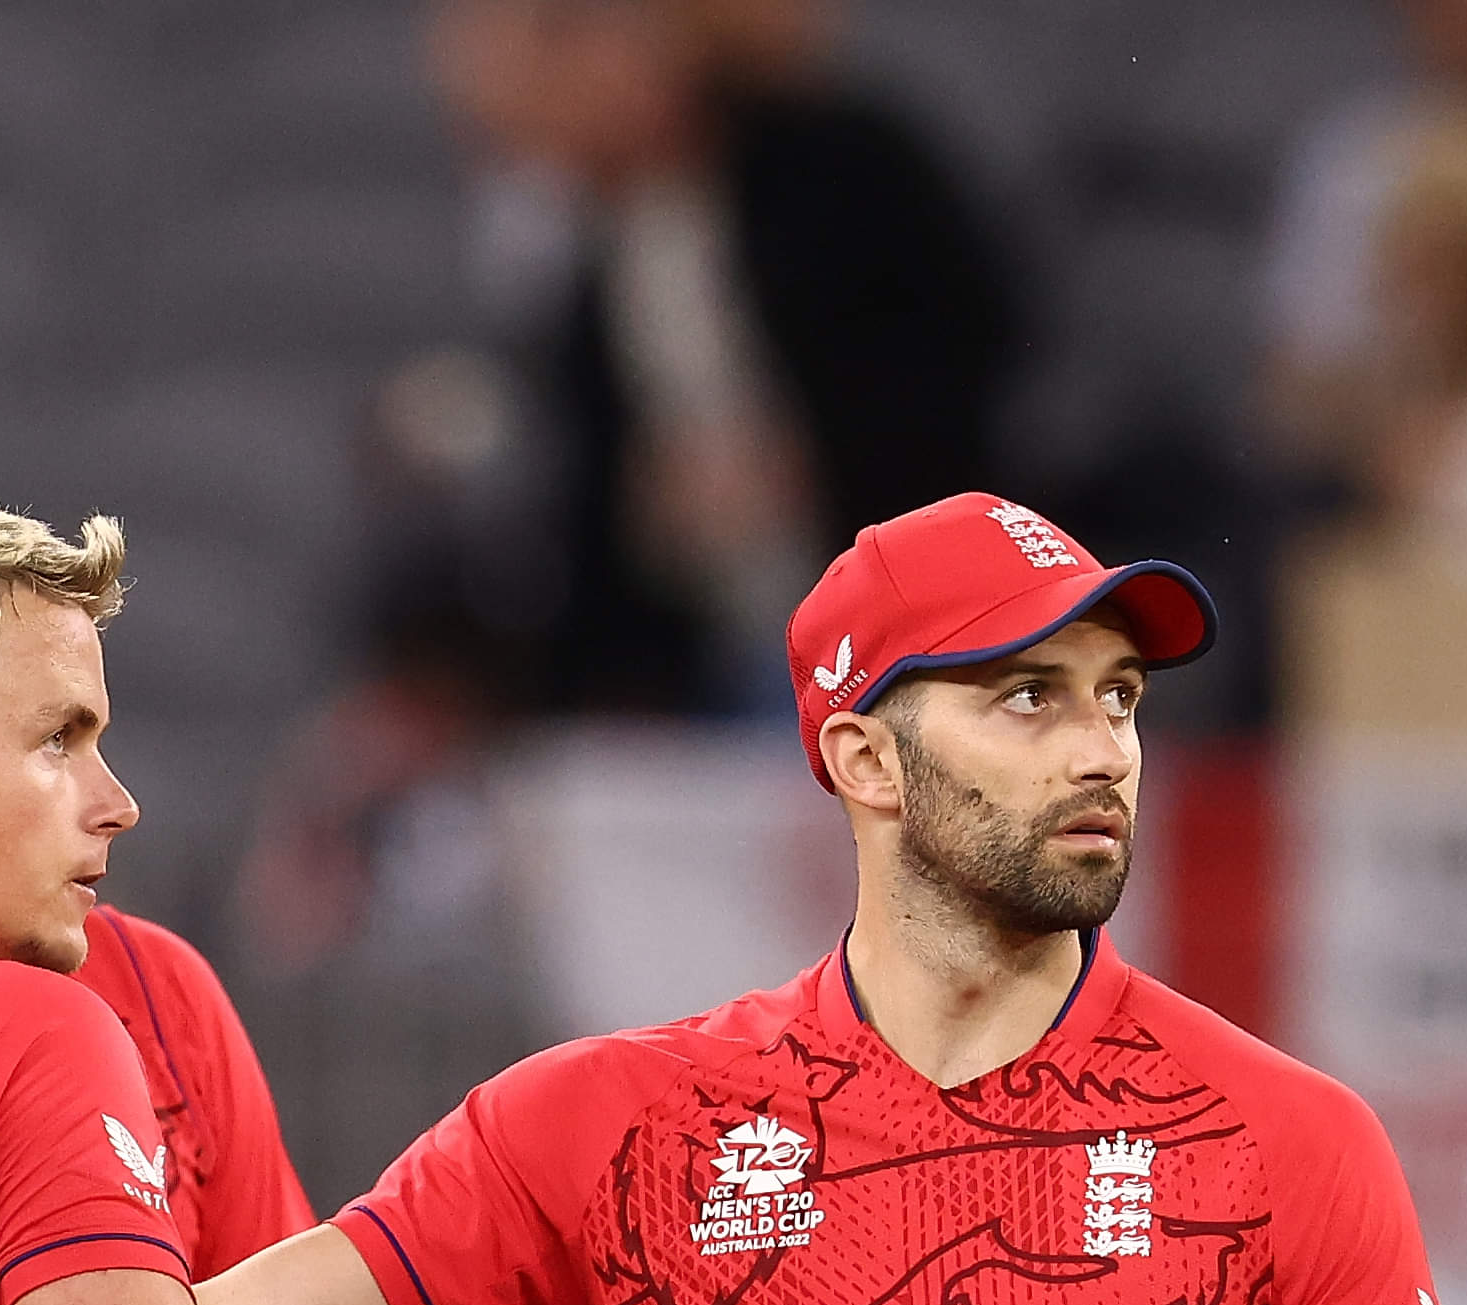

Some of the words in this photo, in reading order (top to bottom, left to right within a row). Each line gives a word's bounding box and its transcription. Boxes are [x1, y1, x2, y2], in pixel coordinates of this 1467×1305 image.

[828, 669, 869, 708] CASTORE
[701, 1196, 771, 1221] MEN'S
[774, 1191, 814, 1213] T20
[709, 1184, 735, 1200] ICC
[690, 1216, 775, 1242] WORLD
[778, 1210, 824, 1233] CUP
[700, 1236, 776, 1256] AUSTRALIA
[777, 1233, 810, 1248] 2022
